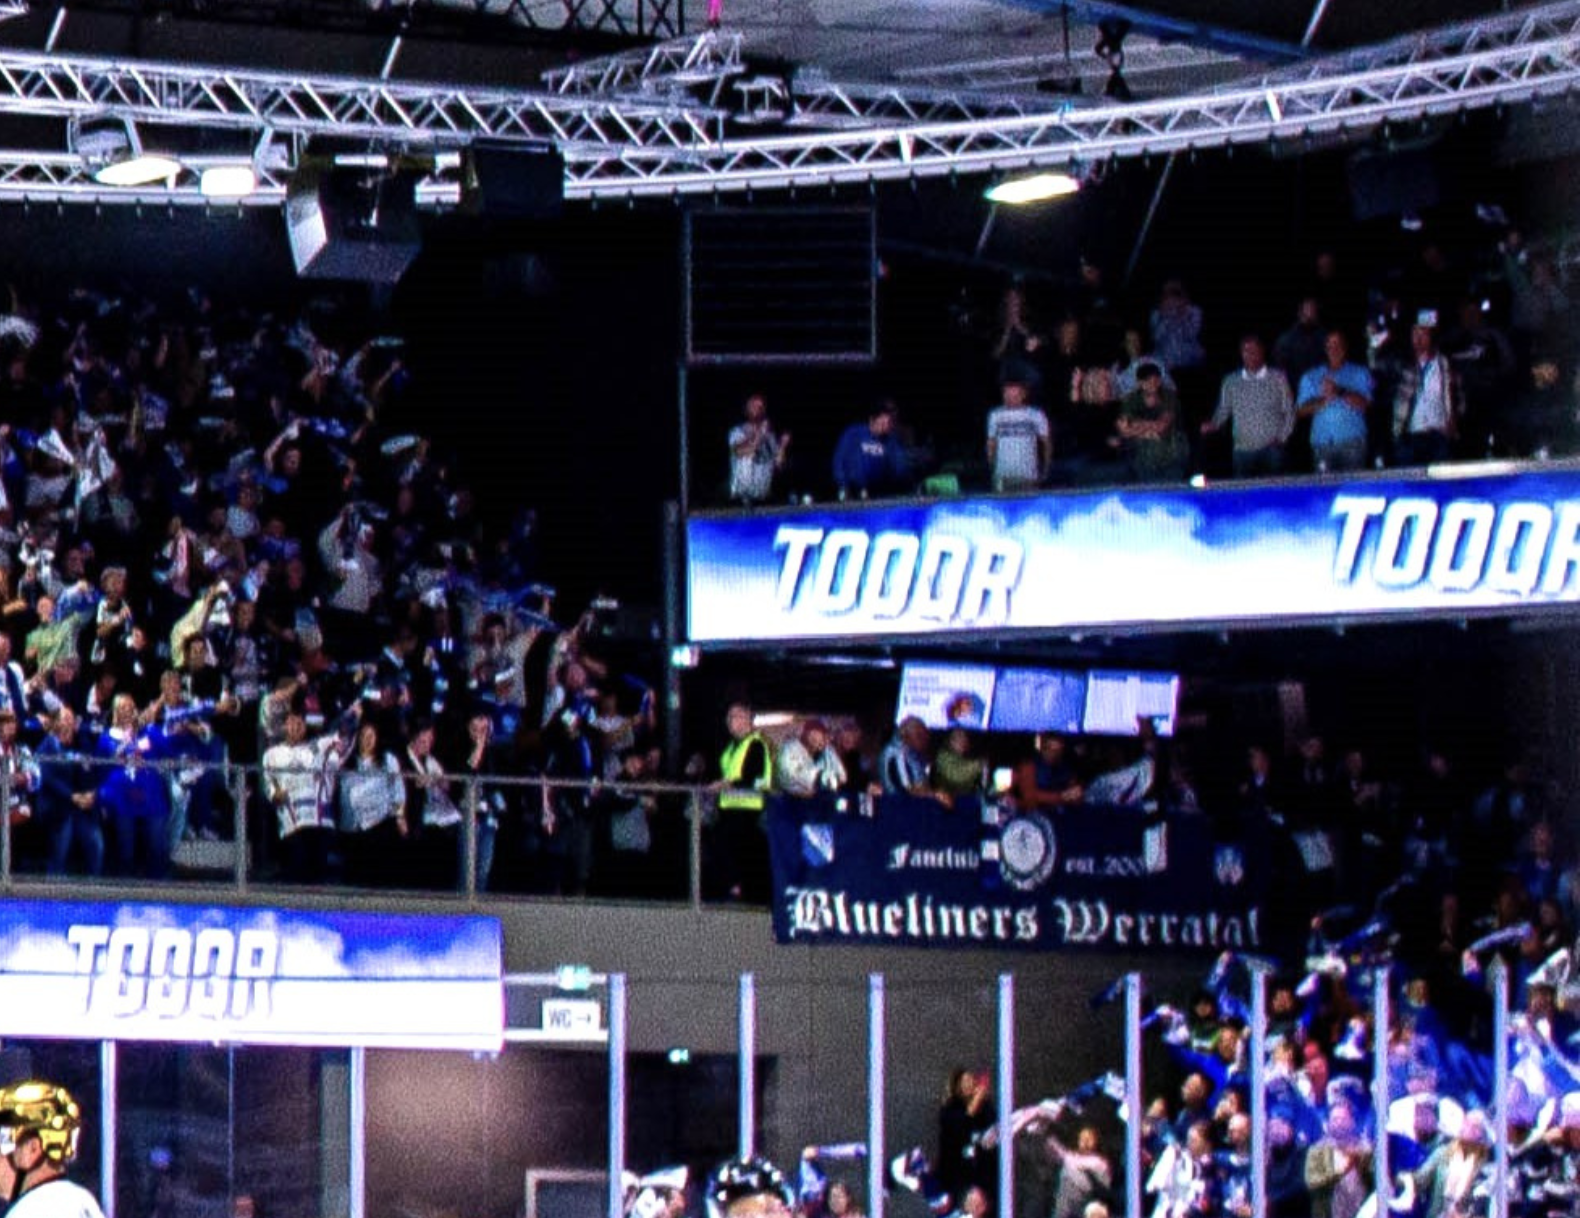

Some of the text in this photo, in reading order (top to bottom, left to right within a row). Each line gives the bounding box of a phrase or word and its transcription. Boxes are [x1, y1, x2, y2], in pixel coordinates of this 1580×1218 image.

[786, 888, 1259, 946] Blueliners Werratal
[548, 1008, 571, 1028] WC
